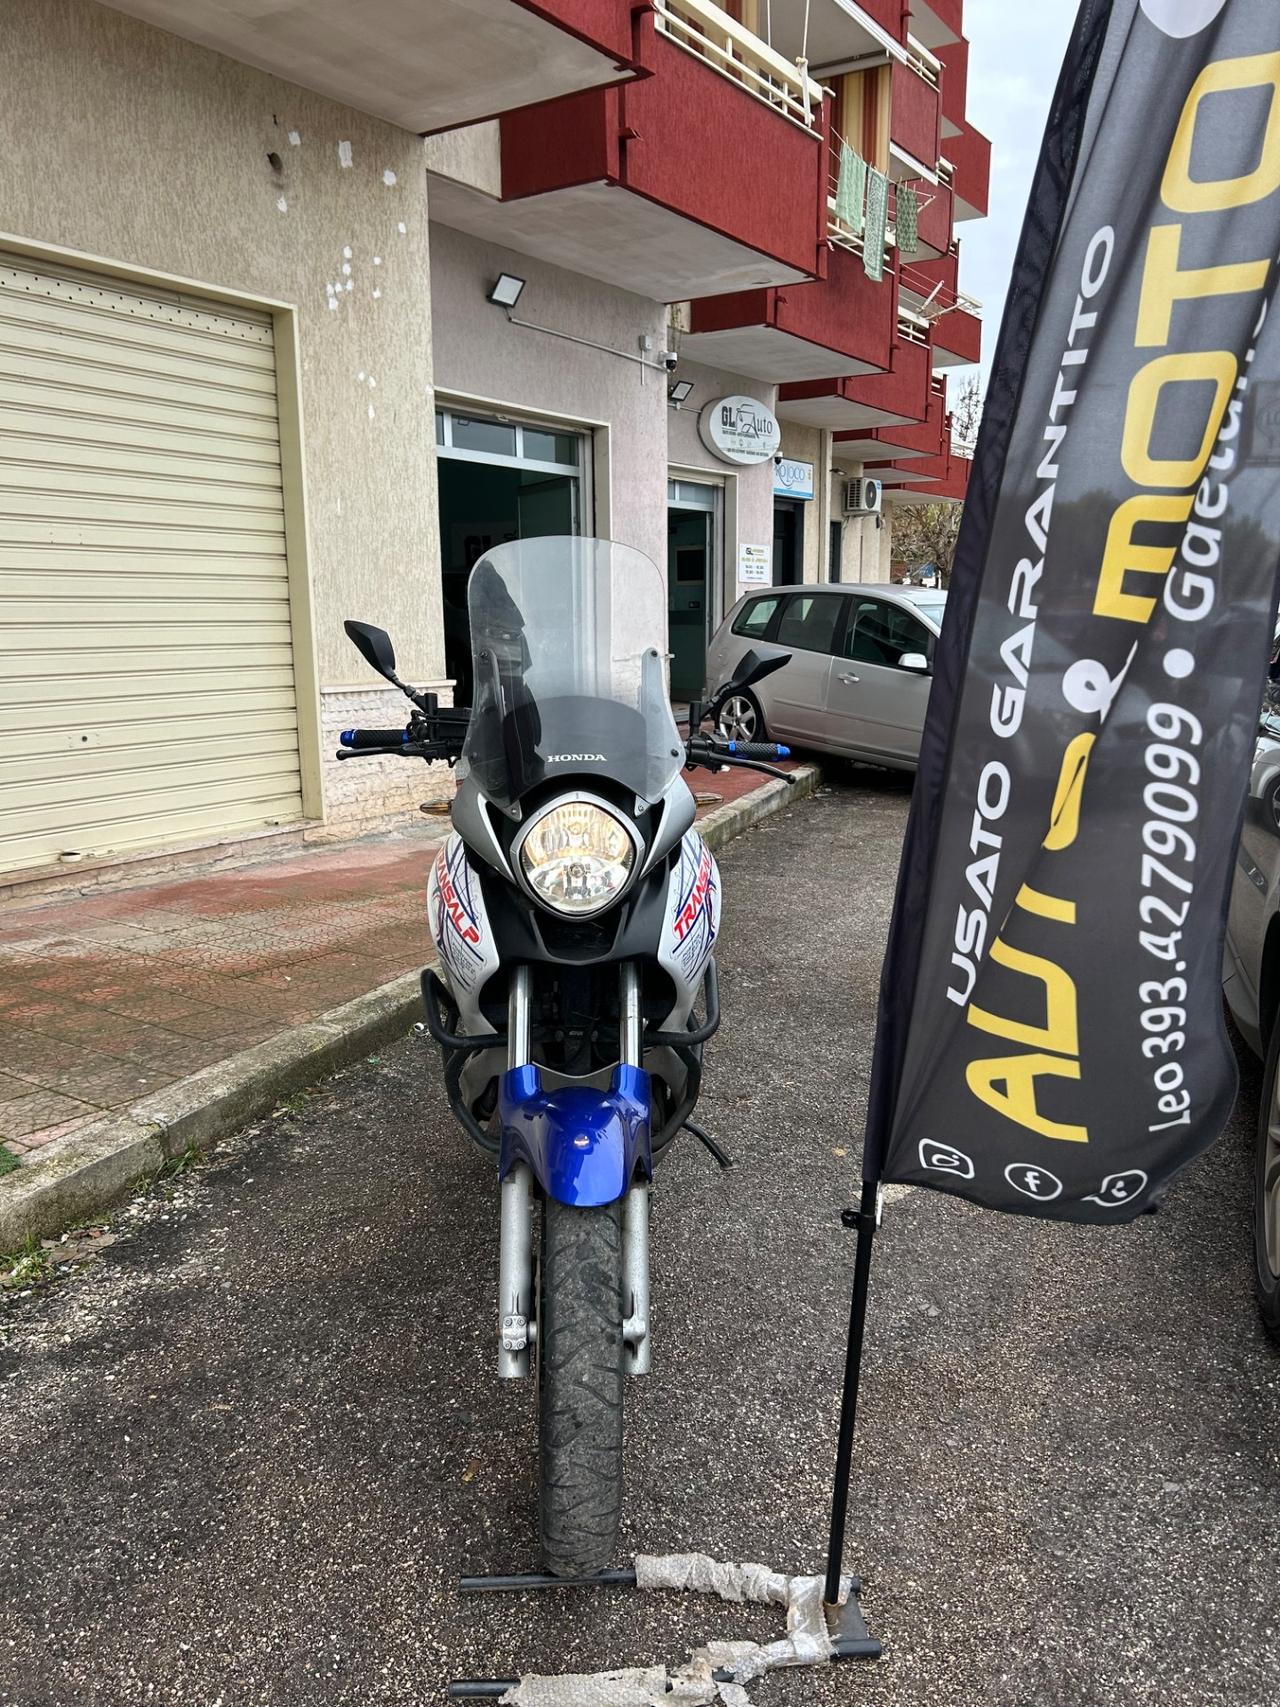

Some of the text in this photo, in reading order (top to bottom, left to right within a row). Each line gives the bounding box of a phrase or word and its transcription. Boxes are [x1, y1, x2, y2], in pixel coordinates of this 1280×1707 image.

[721, 406, 773, 439] GL Auto
[946, 225, 1115, 1007] USATO GARANTITO
[547, 753, 607, 763] HONDA
[1138, 297, 1267, 1132] Leo 393.4279099 Gaet
[436, 849, 480, 944] RANSALP
[674, 843, 711, 940] TRANSA
